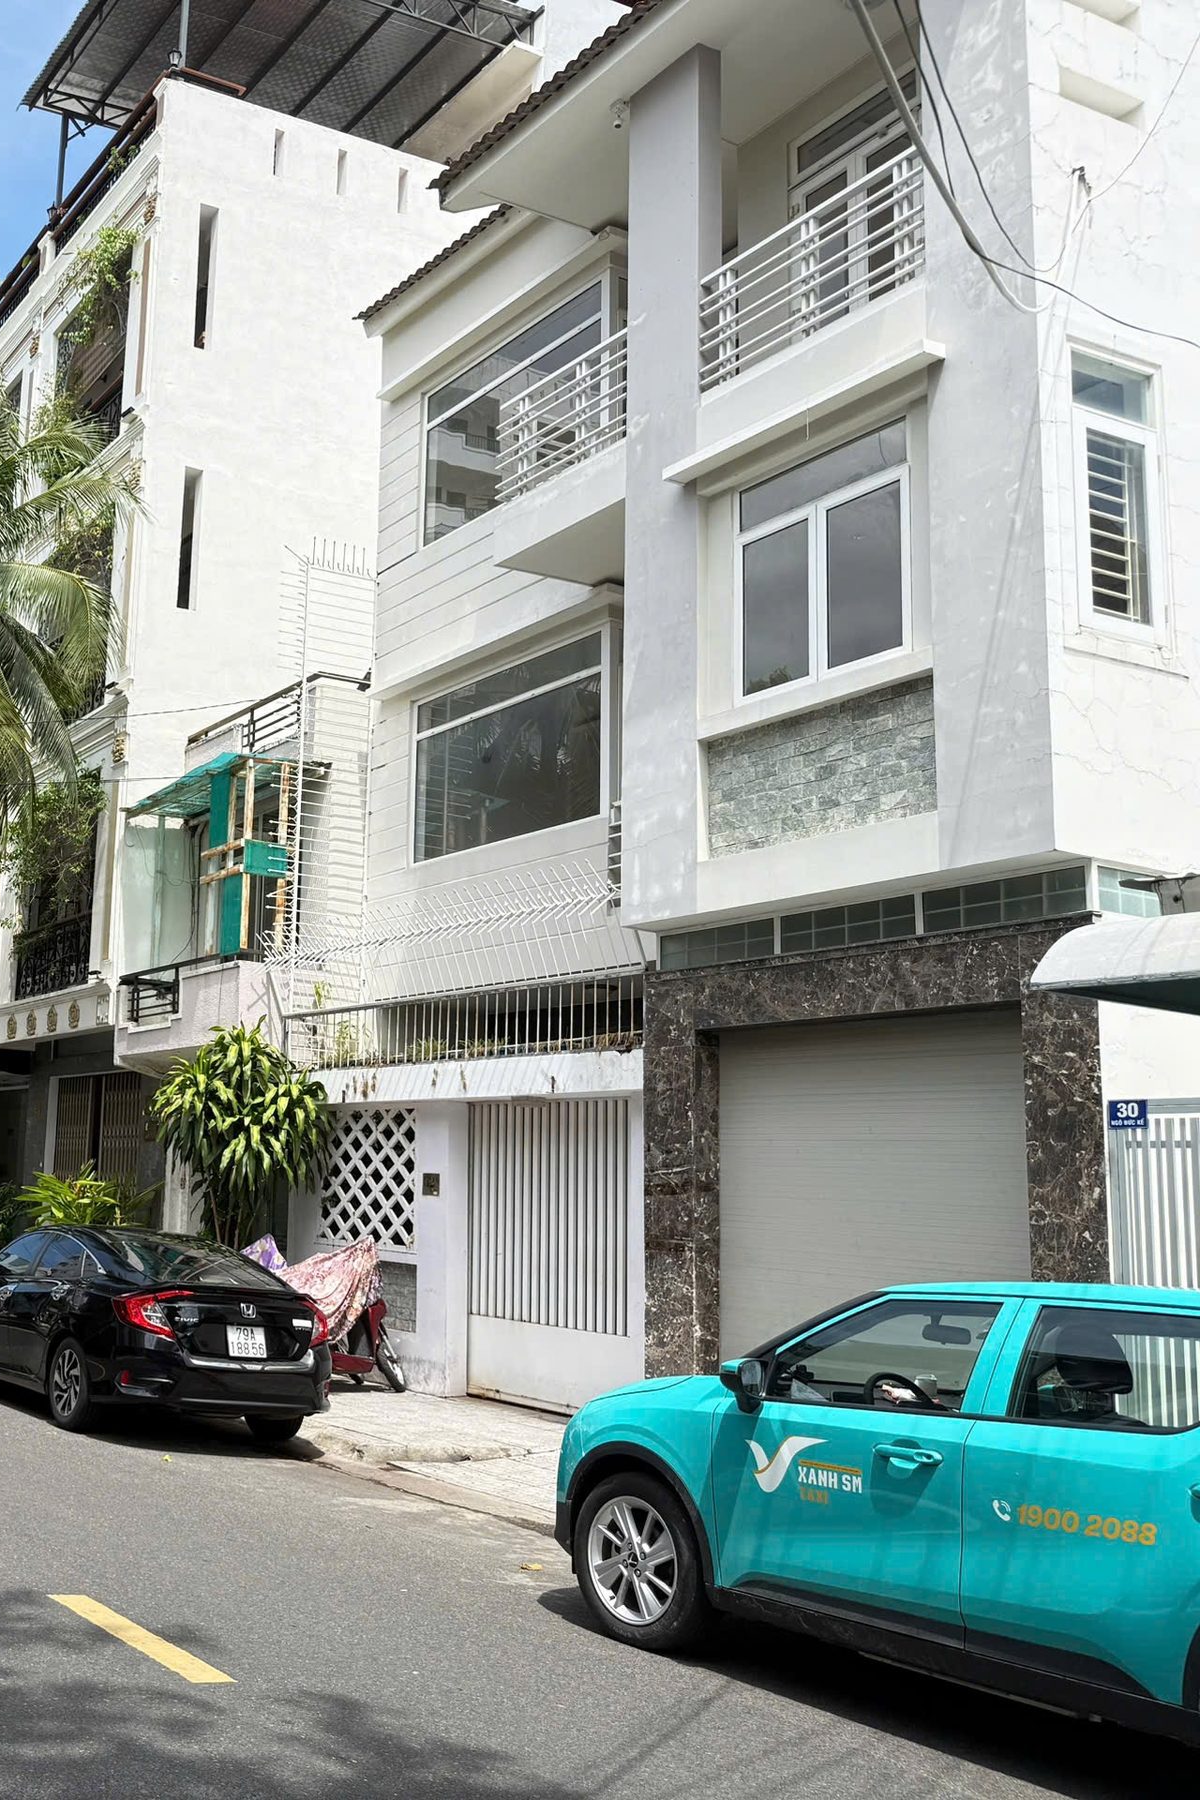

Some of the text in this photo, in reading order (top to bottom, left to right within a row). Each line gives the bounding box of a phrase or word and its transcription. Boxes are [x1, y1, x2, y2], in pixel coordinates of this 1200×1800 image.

[1116, 1102, 1139, 1118] 30
[235, 1327, 256, 1341] 79A
[798, 1466, 863, 1494] XANH SM
[1018, 1503, 1158, 1546] 1900 2088
